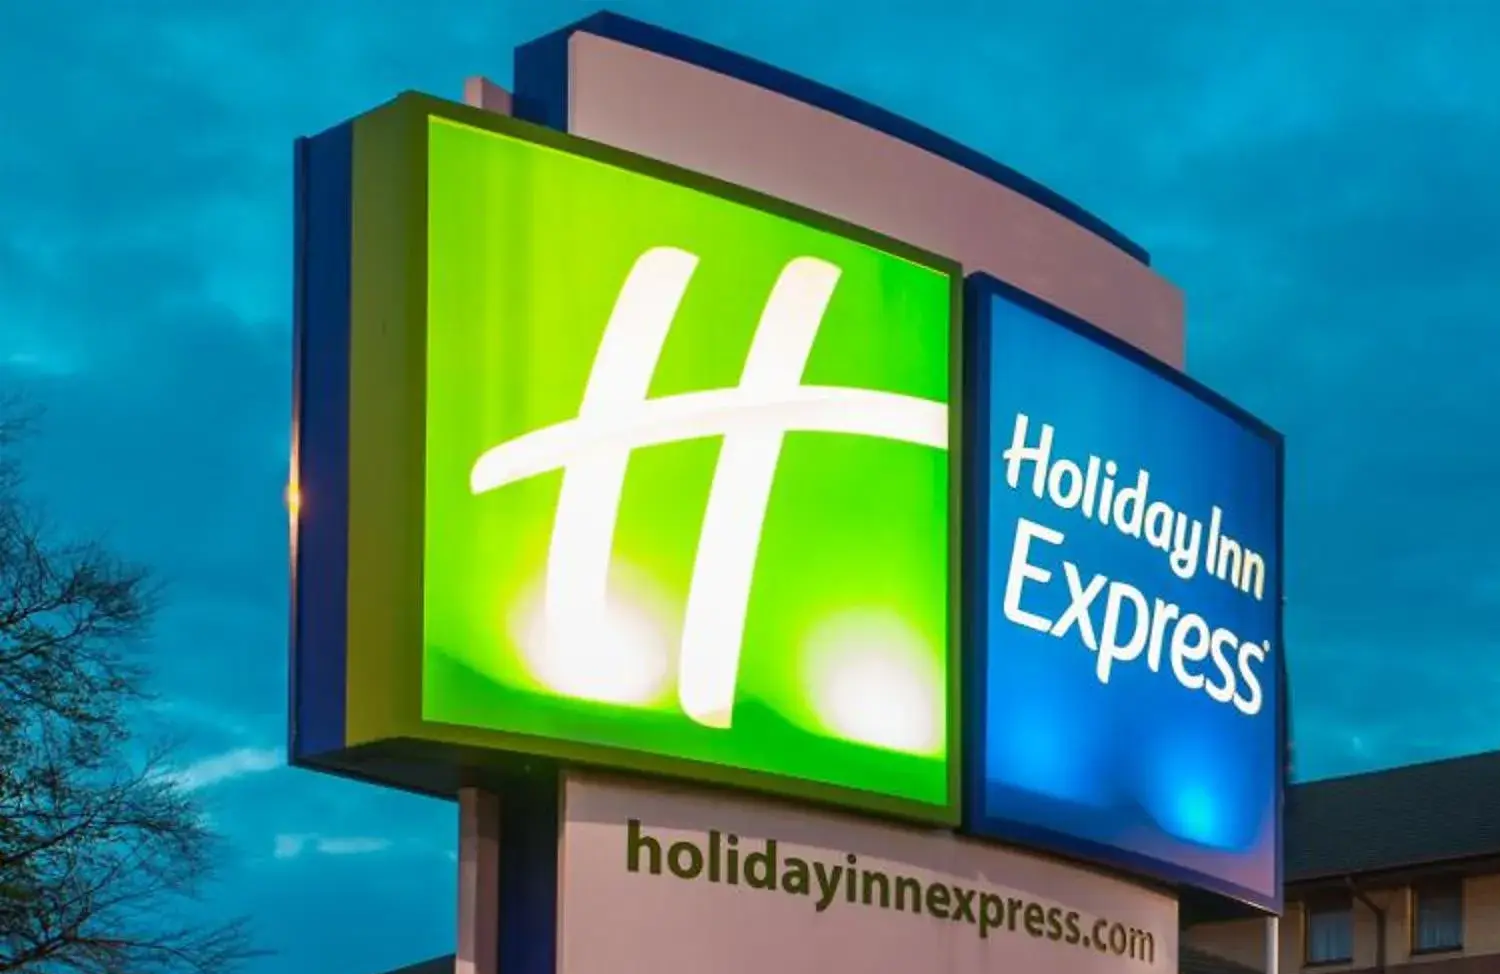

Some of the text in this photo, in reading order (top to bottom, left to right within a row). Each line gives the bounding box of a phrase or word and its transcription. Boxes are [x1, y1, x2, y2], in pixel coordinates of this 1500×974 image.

[1003, 412, 1265, 601] Holiday Inn
[1003, 516, 1266, 716] Express
[625, 818, 1156, 965] holidayinnexpress.com
